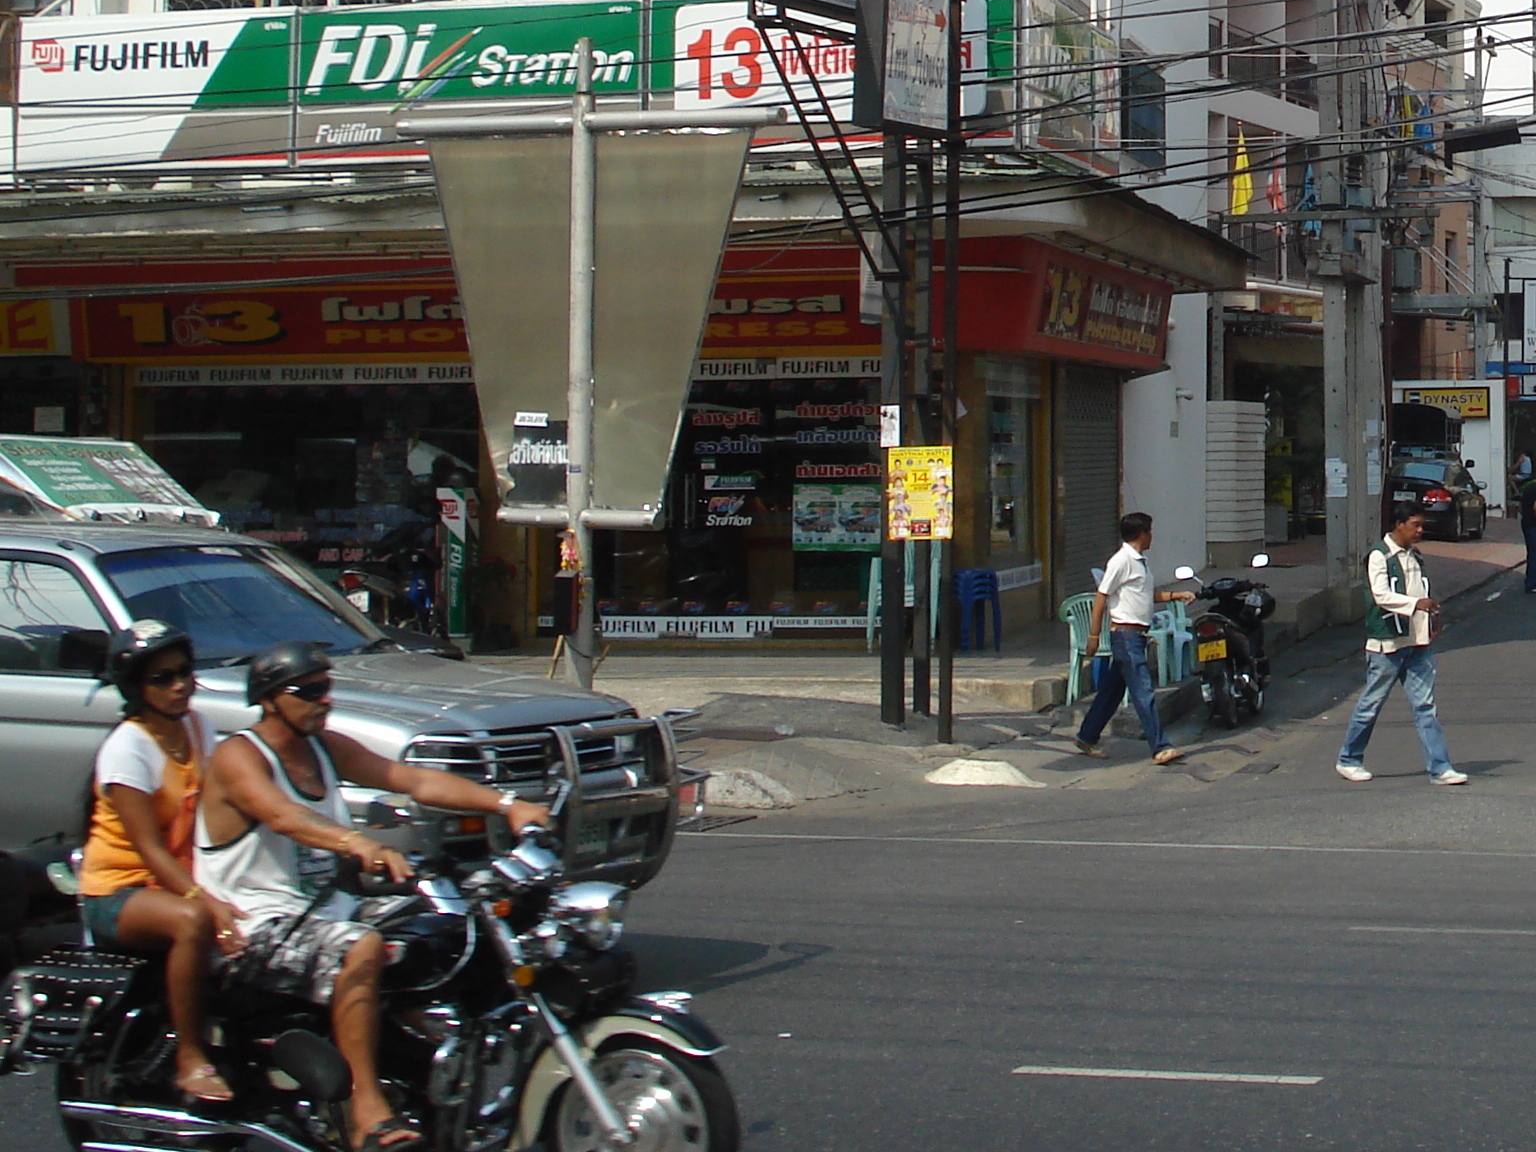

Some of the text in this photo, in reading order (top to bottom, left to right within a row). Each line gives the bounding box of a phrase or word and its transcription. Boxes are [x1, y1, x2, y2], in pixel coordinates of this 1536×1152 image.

[73, 40, 209, 73] FUJIFILM
[303, 23, 437, 96] FDi
[687, 27, 763, 100] 13
[315, 123, 382, 145] Fujifilm
[1047, 270, 1083, 327] 13
[119, 300, 282, 343] 13
[703, 320, 850, 339] RESS
[324, 327, 467, 344] PHO
[138, 365, 474, 383] FUJIFILM FUJIFILM FUJIFILM FUJIFILM FUJIFI
[700, 362, 768, 376] FUJIFILM
[782, 360, 850, 374] FUJIFILM
[1423, 393, 1484, 405] DYNASTY
[911, 472, 929, 483] 14
[706, 514, 753, 527] Station
[601, 620, 656, 634] UJIFILM
